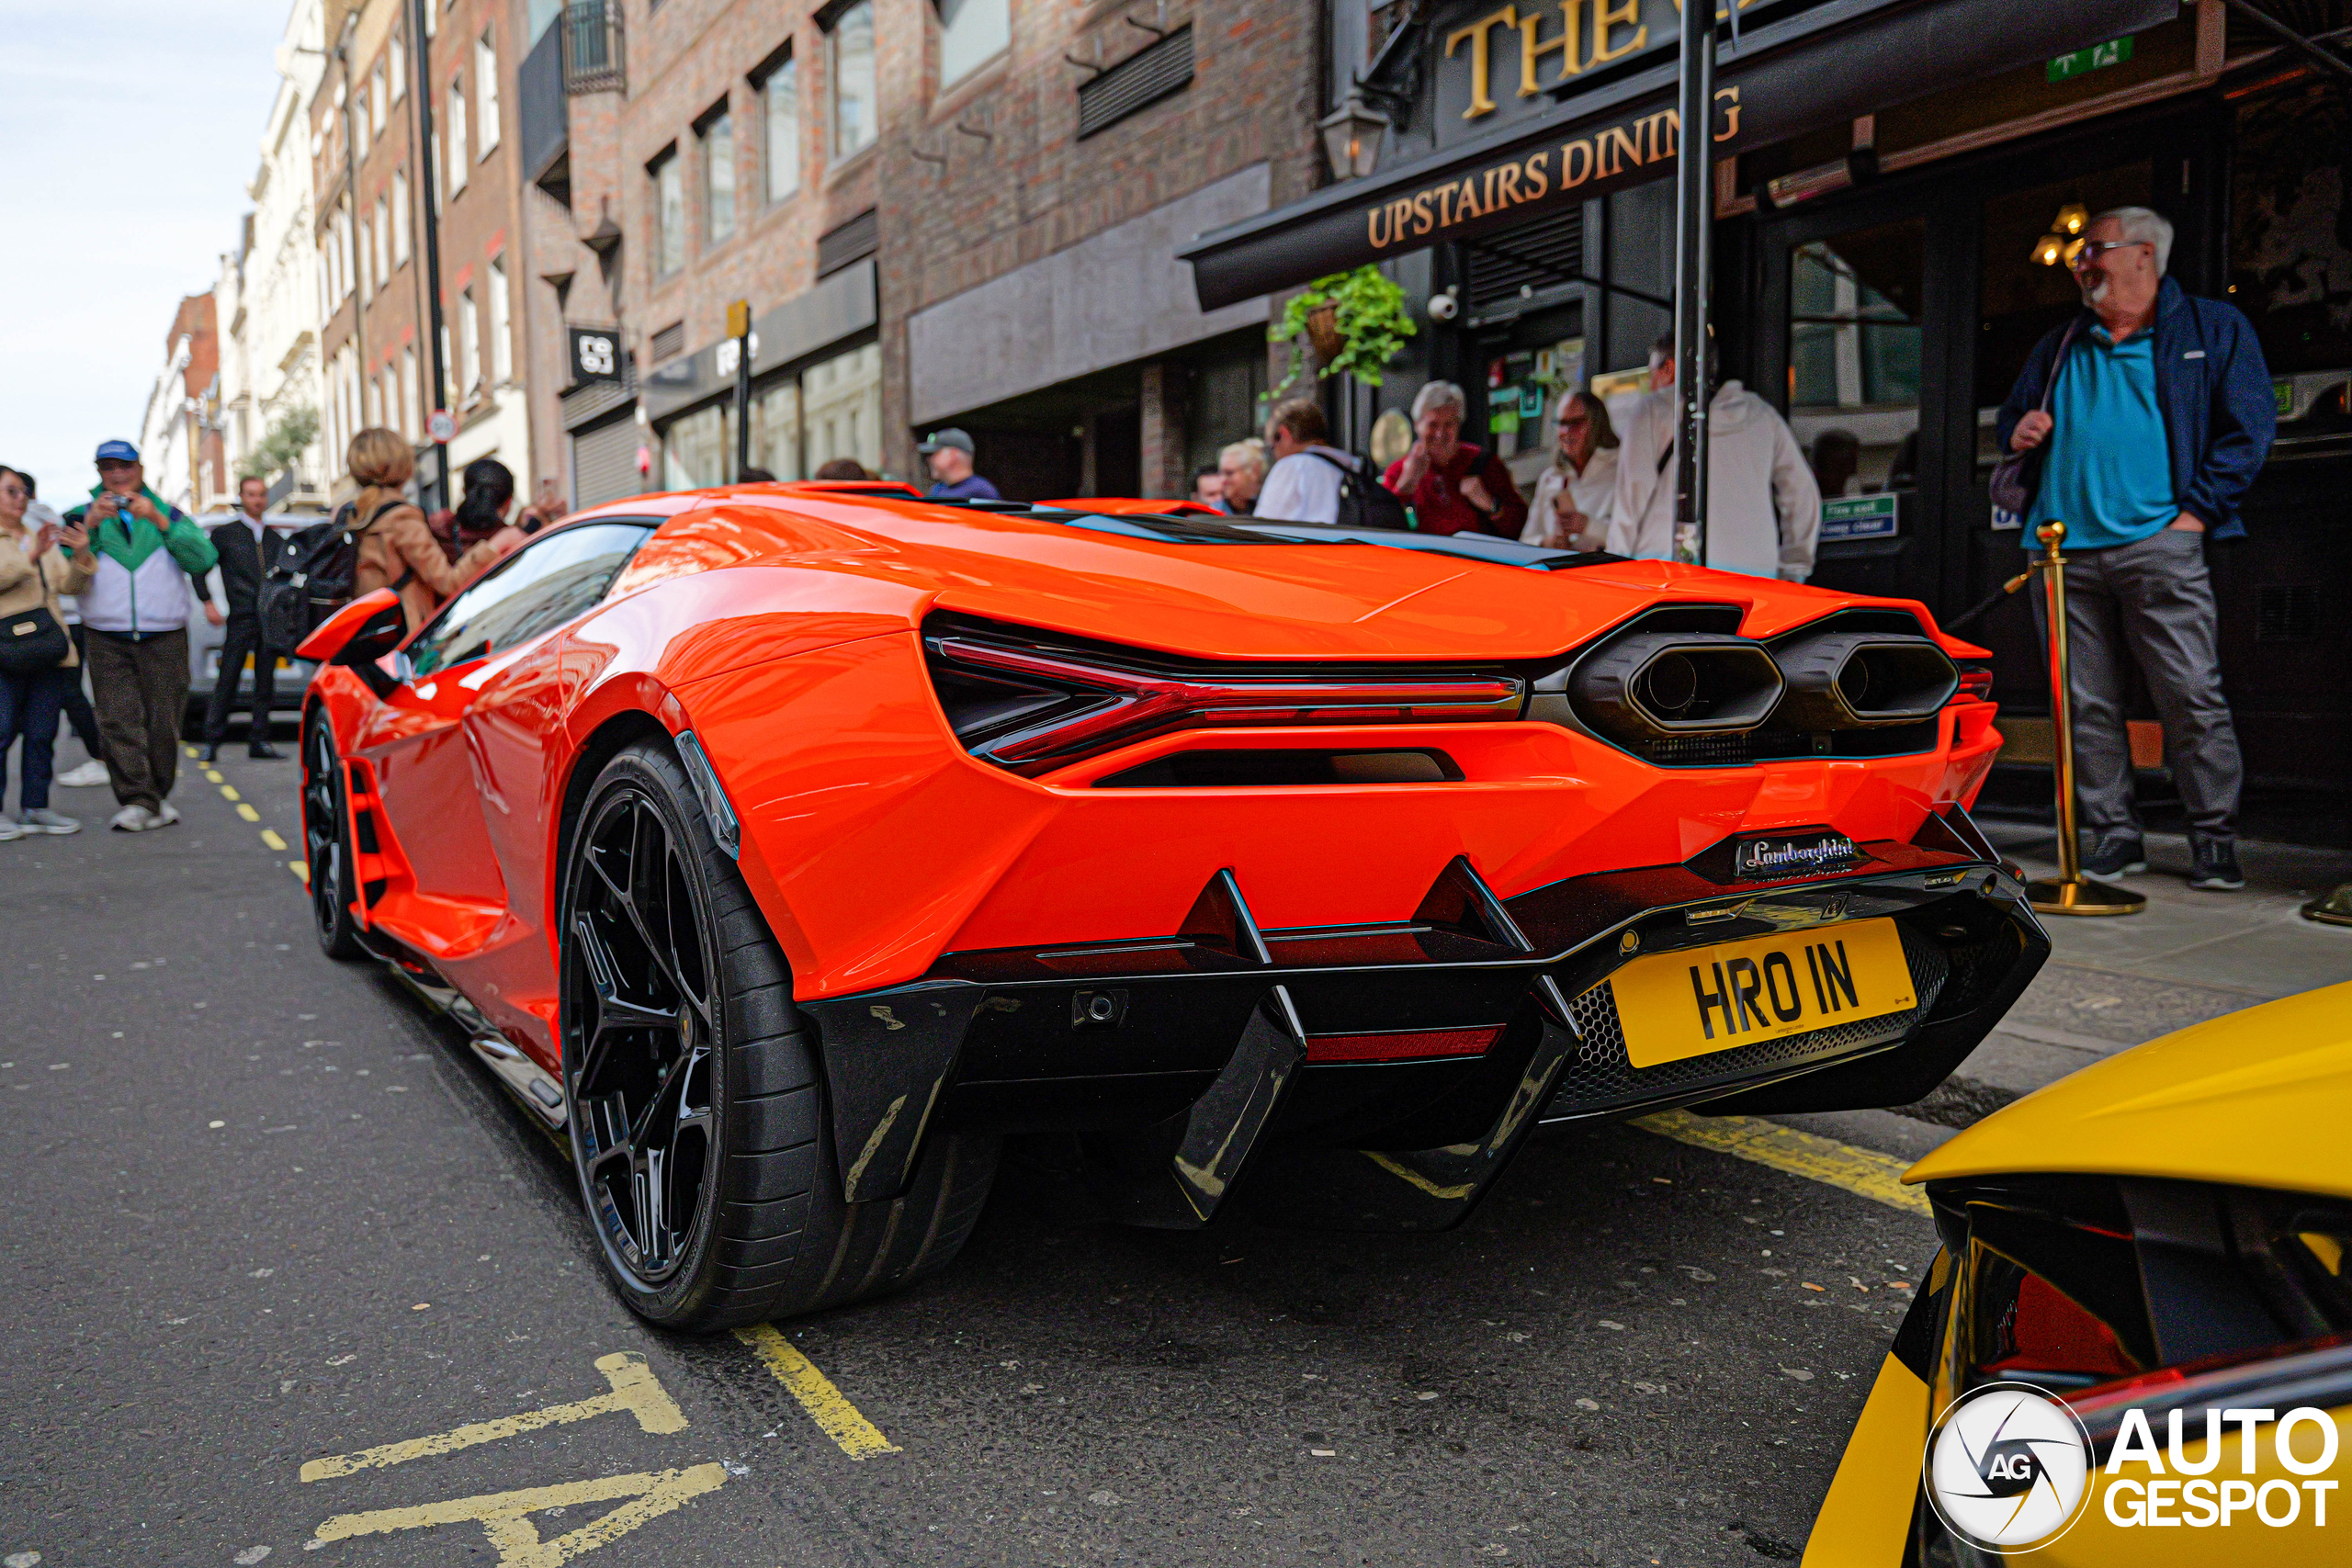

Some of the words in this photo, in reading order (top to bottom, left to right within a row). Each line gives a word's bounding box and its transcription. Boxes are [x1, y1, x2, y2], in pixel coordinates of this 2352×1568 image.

[1444, 0, 1648, 119] THE
[1366, 151, 1550, 249] UPSTAIRS
[1746, 837, 1855, 867] Lamborghini
